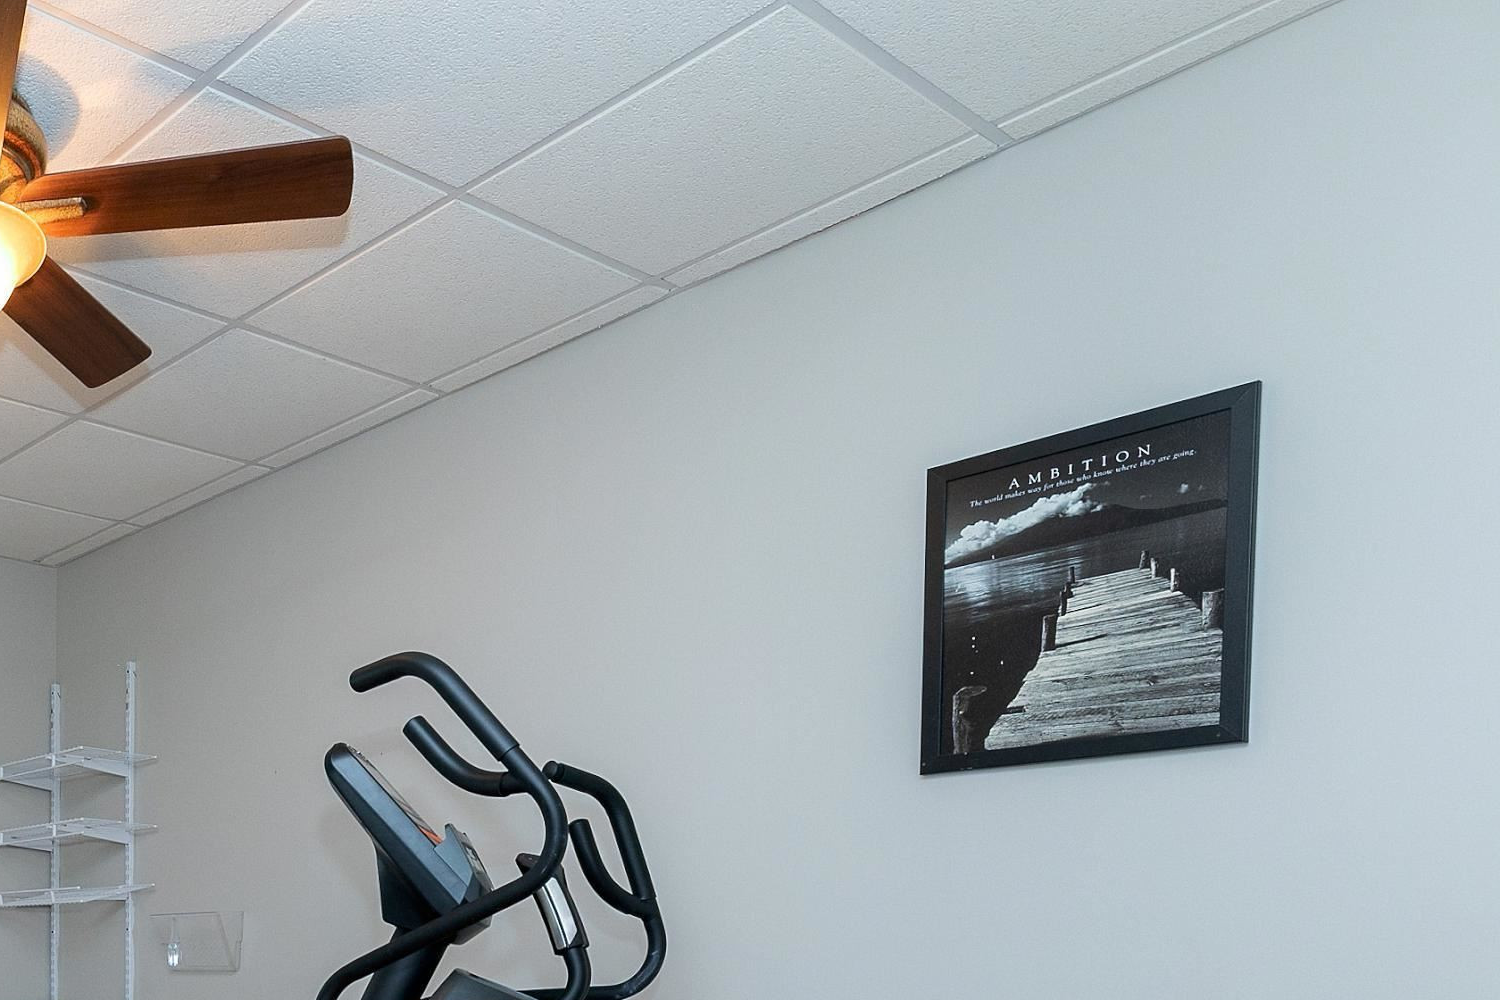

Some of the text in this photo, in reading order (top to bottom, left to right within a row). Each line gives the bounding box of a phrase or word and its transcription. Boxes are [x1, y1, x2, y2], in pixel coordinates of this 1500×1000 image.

[969, 448, 1197, 508] The world makes way for those who know where they are going.
[1008, 444, 1151, 490] AMBITION
